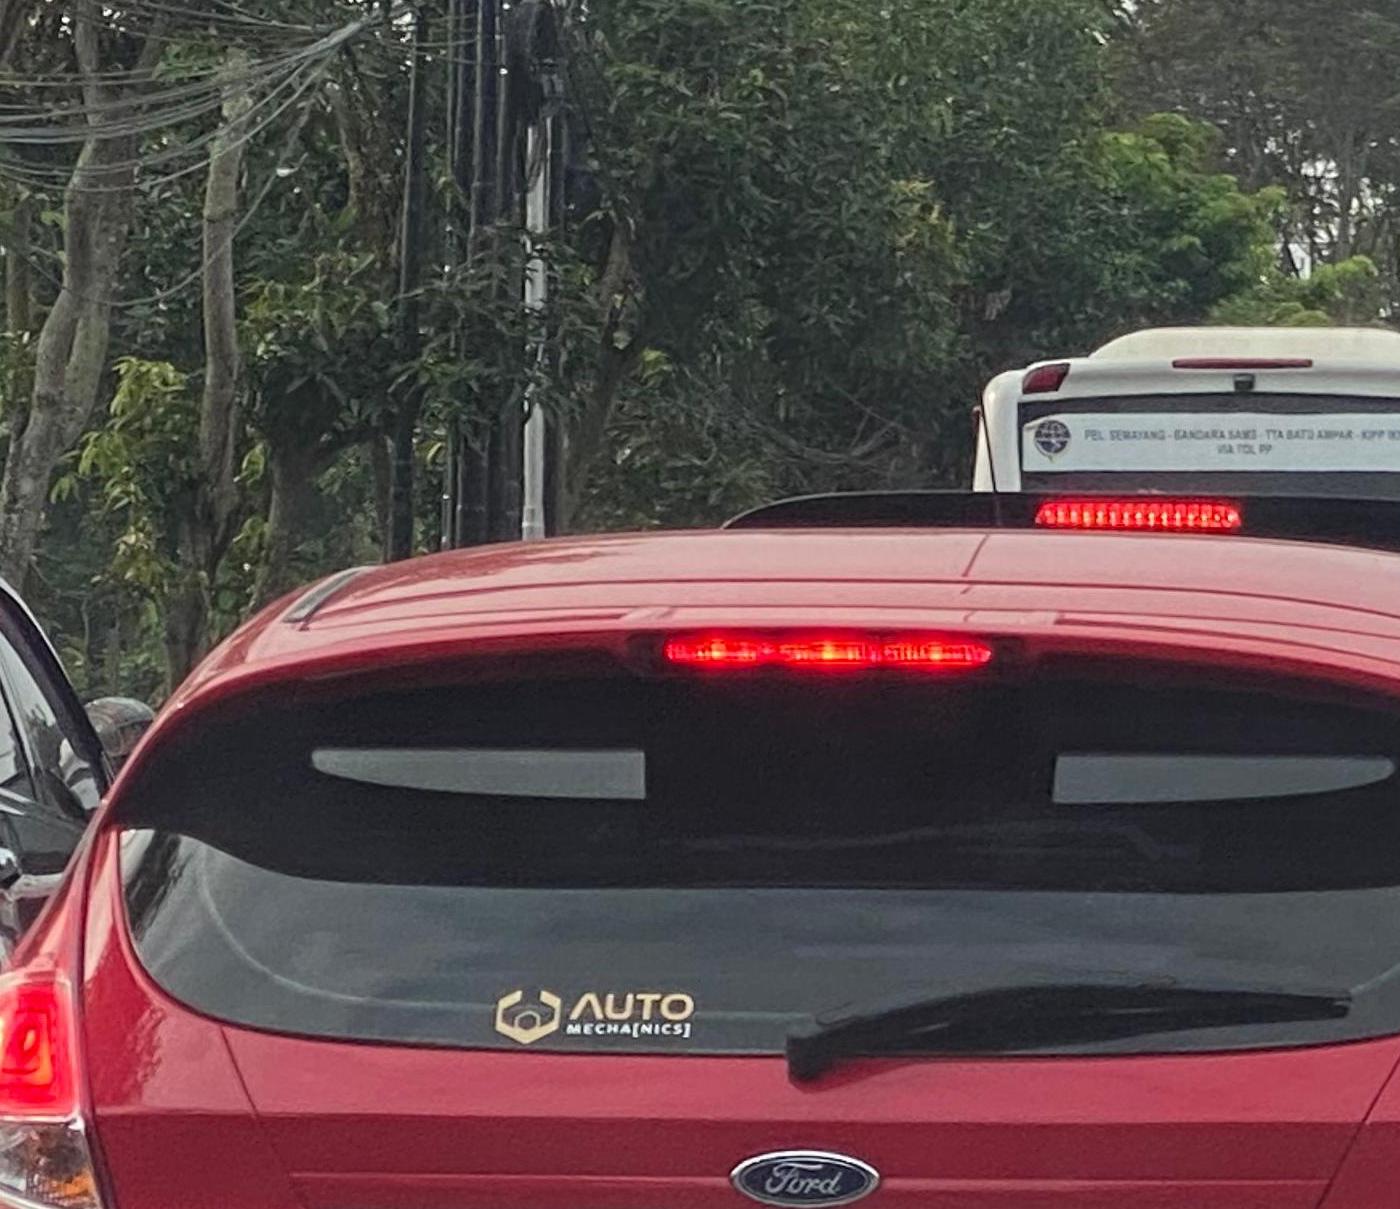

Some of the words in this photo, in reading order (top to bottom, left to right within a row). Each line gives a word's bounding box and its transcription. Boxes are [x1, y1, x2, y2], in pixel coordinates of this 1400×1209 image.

[1109, 429, 1166, 441] SEMAYANG
[1286, 429, 1315, 440] BATU
[1317, 429, 1353, 440] AMPAR
[1217, 443, 1234, 454] VIA
[1237, 443, 1256, 454] TOL
[569, 992, 694, 1020] AUTO
[566, 1022, 691, 1038] MECHA[NICS]
[765, 1162, 842, 1195] Ford
